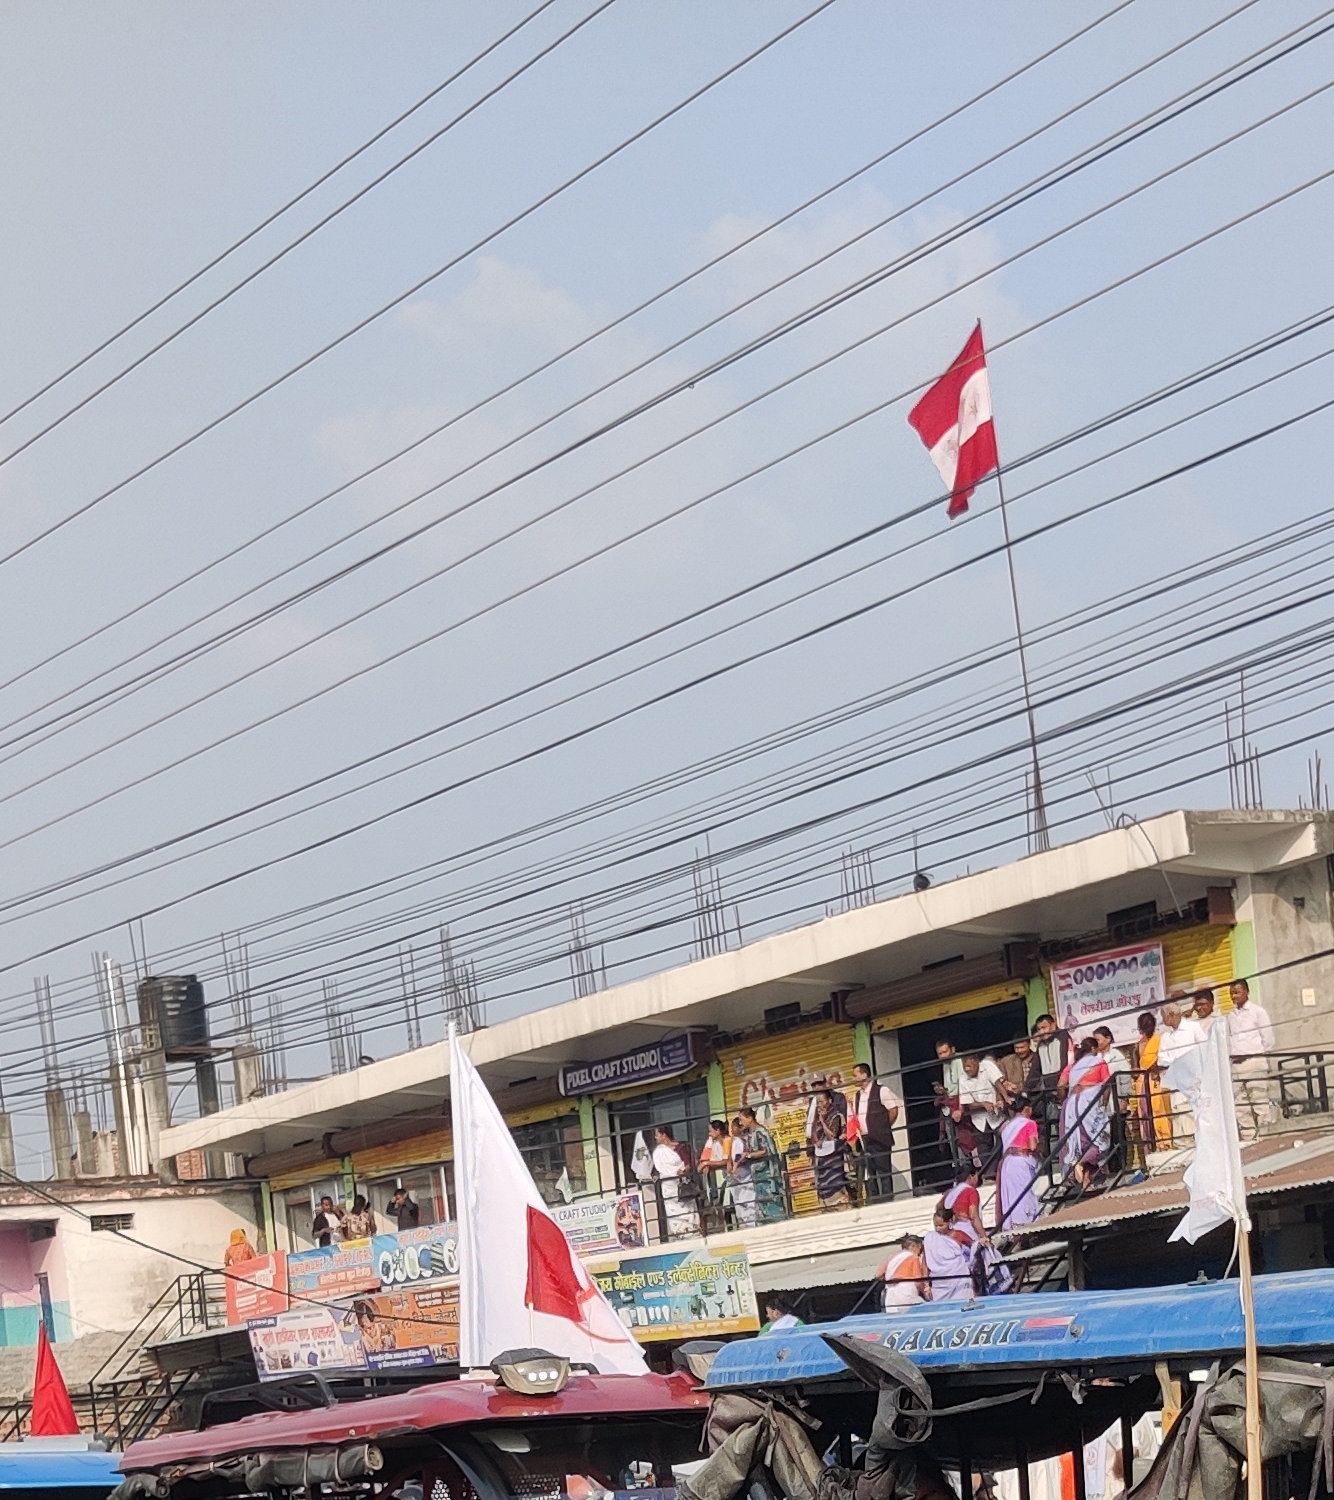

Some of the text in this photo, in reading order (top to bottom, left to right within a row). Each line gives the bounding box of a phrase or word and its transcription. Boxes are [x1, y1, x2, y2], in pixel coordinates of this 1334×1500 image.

[567, 1069, 592, 1089] PIXEL
[591, 1060, 621, 1082] CRAFT
[622, 1049, 657, 1074] STUDIO
[559, 1208, 580, 1221] CRAFT
[581, 1202, 607, 1217] STUDIO
[881, 1319, 1019, 1352] SAKSHI
